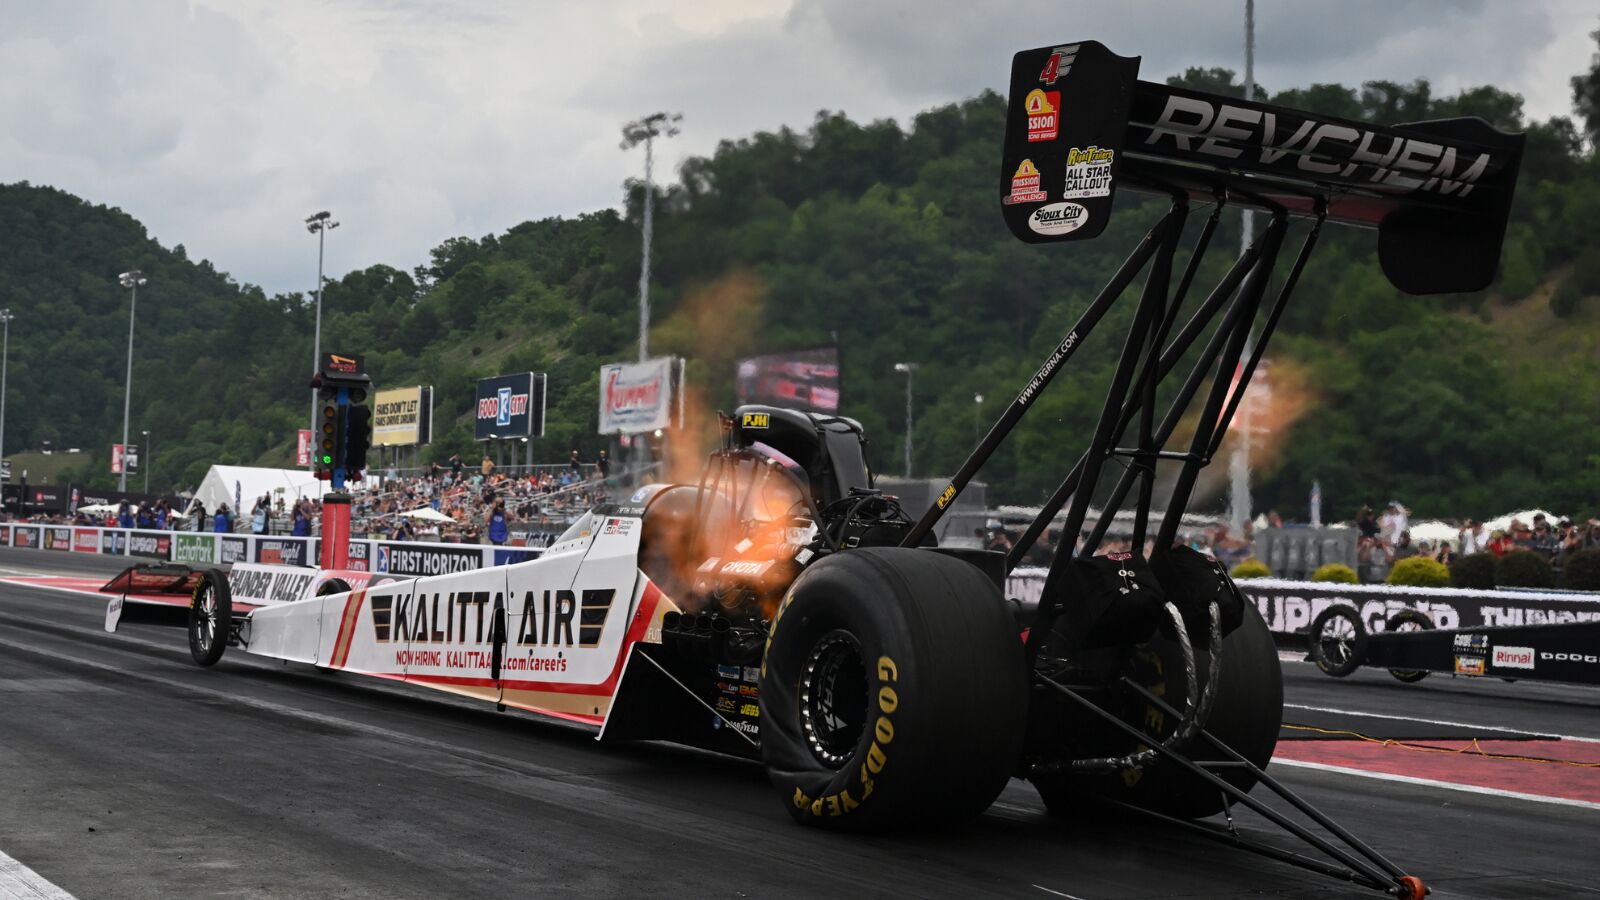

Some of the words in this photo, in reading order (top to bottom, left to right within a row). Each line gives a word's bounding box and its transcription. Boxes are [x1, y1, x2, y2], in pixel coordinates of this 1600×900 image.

[1039, 52, 1062, 86] 4
[1145, 95, 1490, 197] REVCHEM
[1067, 169, 1083, 180] ALL
[1086, 166, 1109, 179] STAR
[1066, 177, 1109, 191] CALLOUT
[1014, 193, 1046, 201] CHALLENGE
[1034, 208, 1061, 221] Sioux
[1064, 206, 1084, 218] City
[1018, 331, 1078, 405] WWW.TGRNA.COM
[376, 403, 388, 415] FANS
[390, 401, 406, 414] DON'T
[407, 400, 417, 412] LET
[478, 397, 499, 419] FOOD
[510, 394, 528, 416] CITY
[743, 415, 768, 427] PJH
[937, 485, 956, 507] PJH
[178, 537, 212, 562] EchoPark
[349, 544, 367, 559] CKER
[390, 550, 422, 573] FIRST
[423, 551, 478, 574] HORIZON
[721, 560, 762, 574] OYOTA
[229, 569, 272, 599] THUNDER
[270, 573, 314, 601] VALLEY
[393, 592, 507, 647] KALITTA
[517, 590, 577, 647] AIR
[396, 651, 414, 665] NOW
[415, 651, 441, 667] HIRING
[446, 651, 567, 672] KALITTAAR.com/careers
[1496, 651, 1531, 664] Rinnai
[1540, 652, 1600, 663] DODG
[740, 704, 760, 717] JEGS
